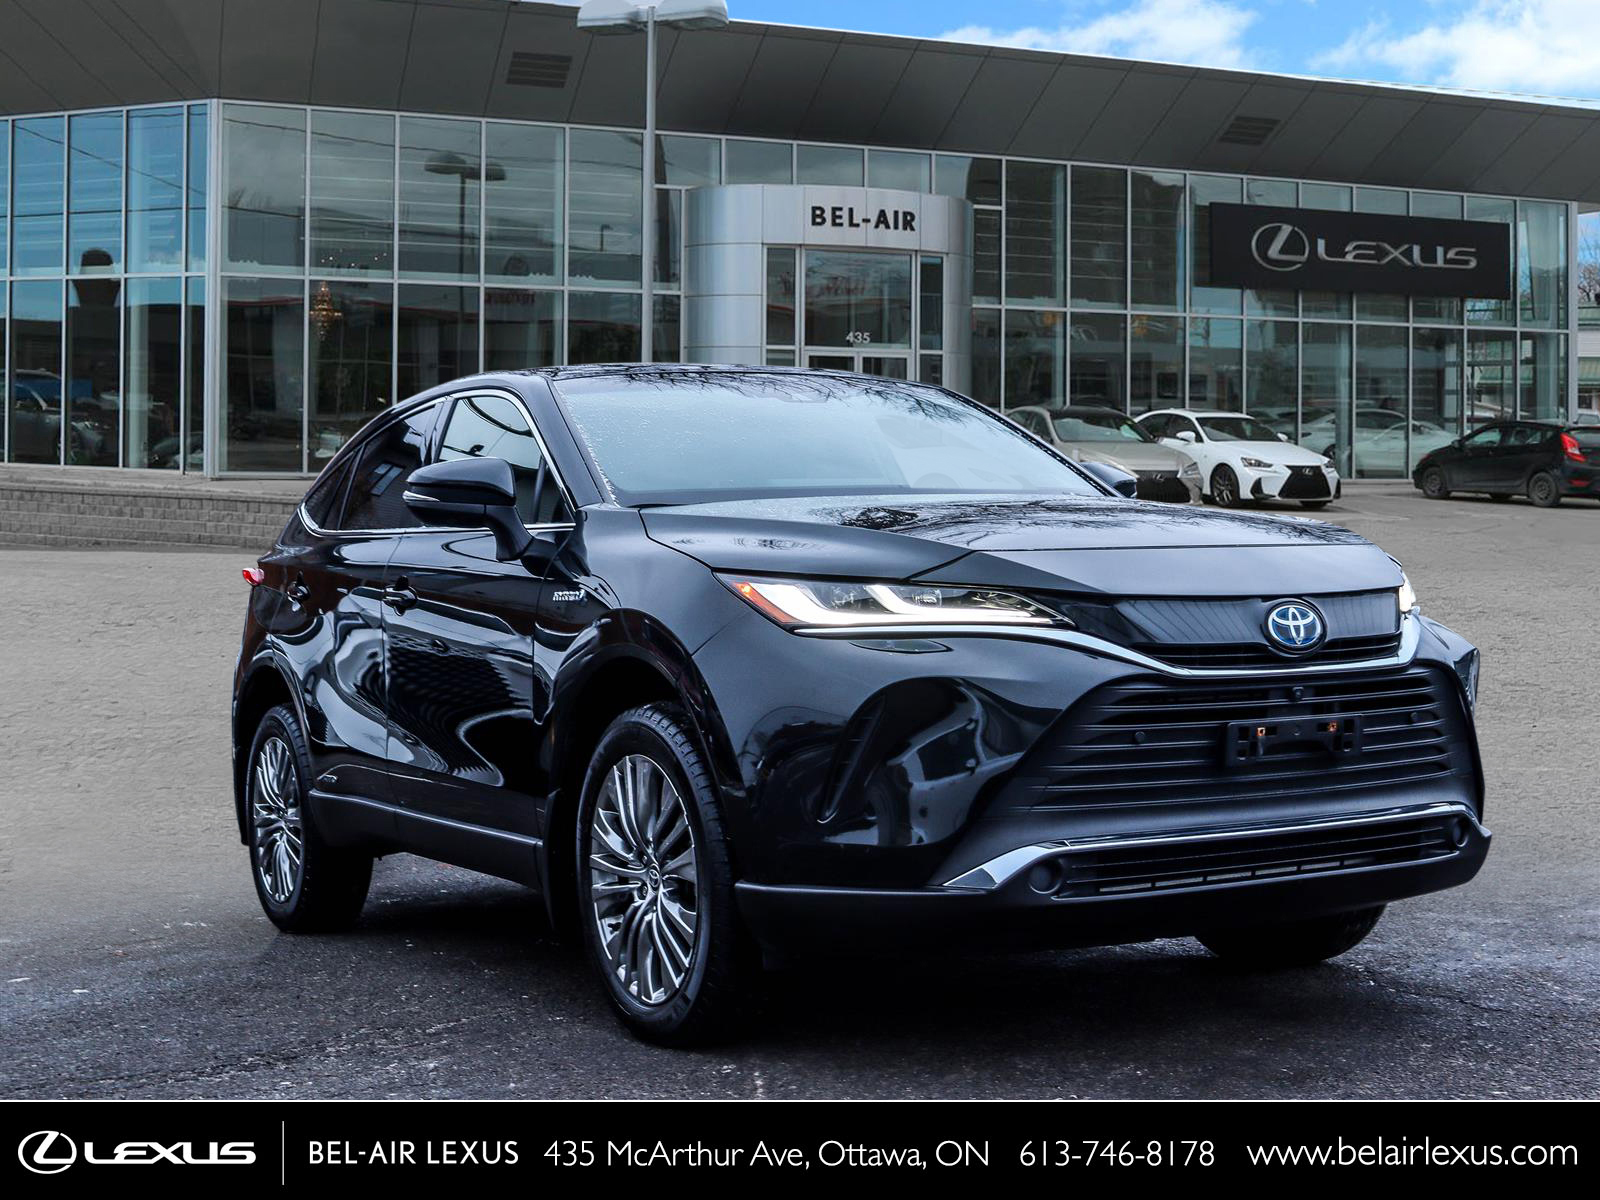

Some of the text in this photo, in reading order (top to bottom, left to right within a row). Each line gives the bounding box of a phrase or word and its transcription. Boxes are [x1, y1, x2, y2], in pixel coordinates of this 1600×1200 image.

[811, 206, 916, 231] BEL-AIR
[1317, 237, 1478, 270] LEXUS
[846, 331, 871, 344] 435
